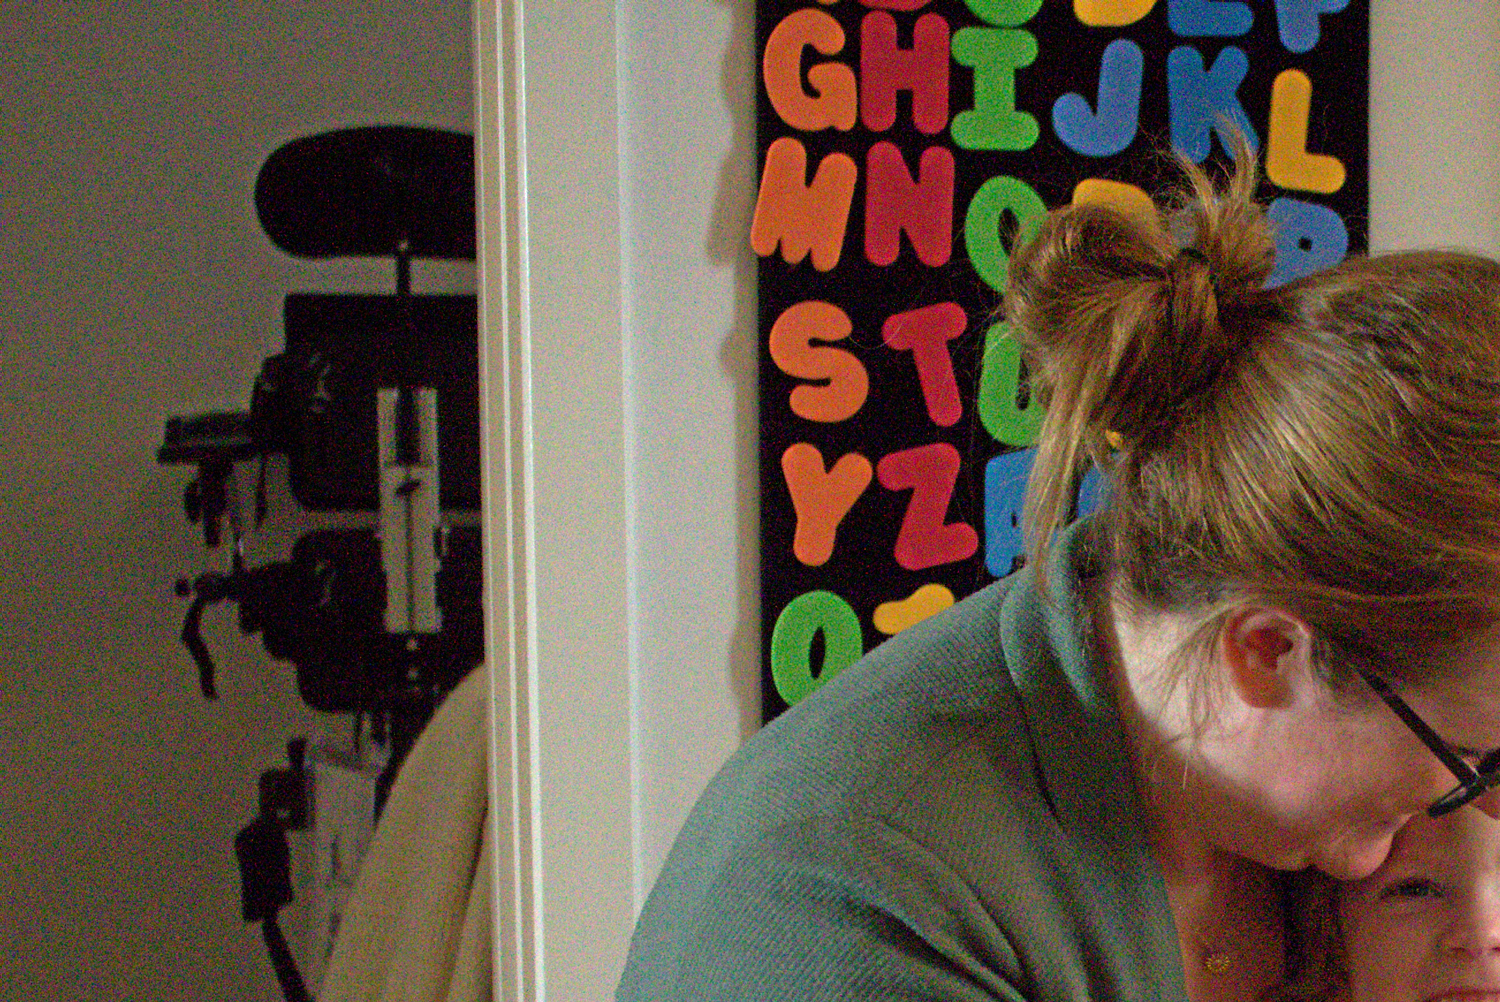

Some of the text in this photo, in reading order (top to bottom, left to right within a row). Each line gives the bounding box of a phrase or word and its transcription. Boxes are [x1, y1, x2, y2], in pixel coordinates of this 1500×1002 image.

[763, 7, 1346, 194] G H I J K L
[751, 136, 858, 272] M
[864, 141, 955, 267] N
[769, 300, 869, 422] S
[882, 302, 967, 426] T
[781, 442, 873, 566] Y
[877, 442, 979, 571] Z
